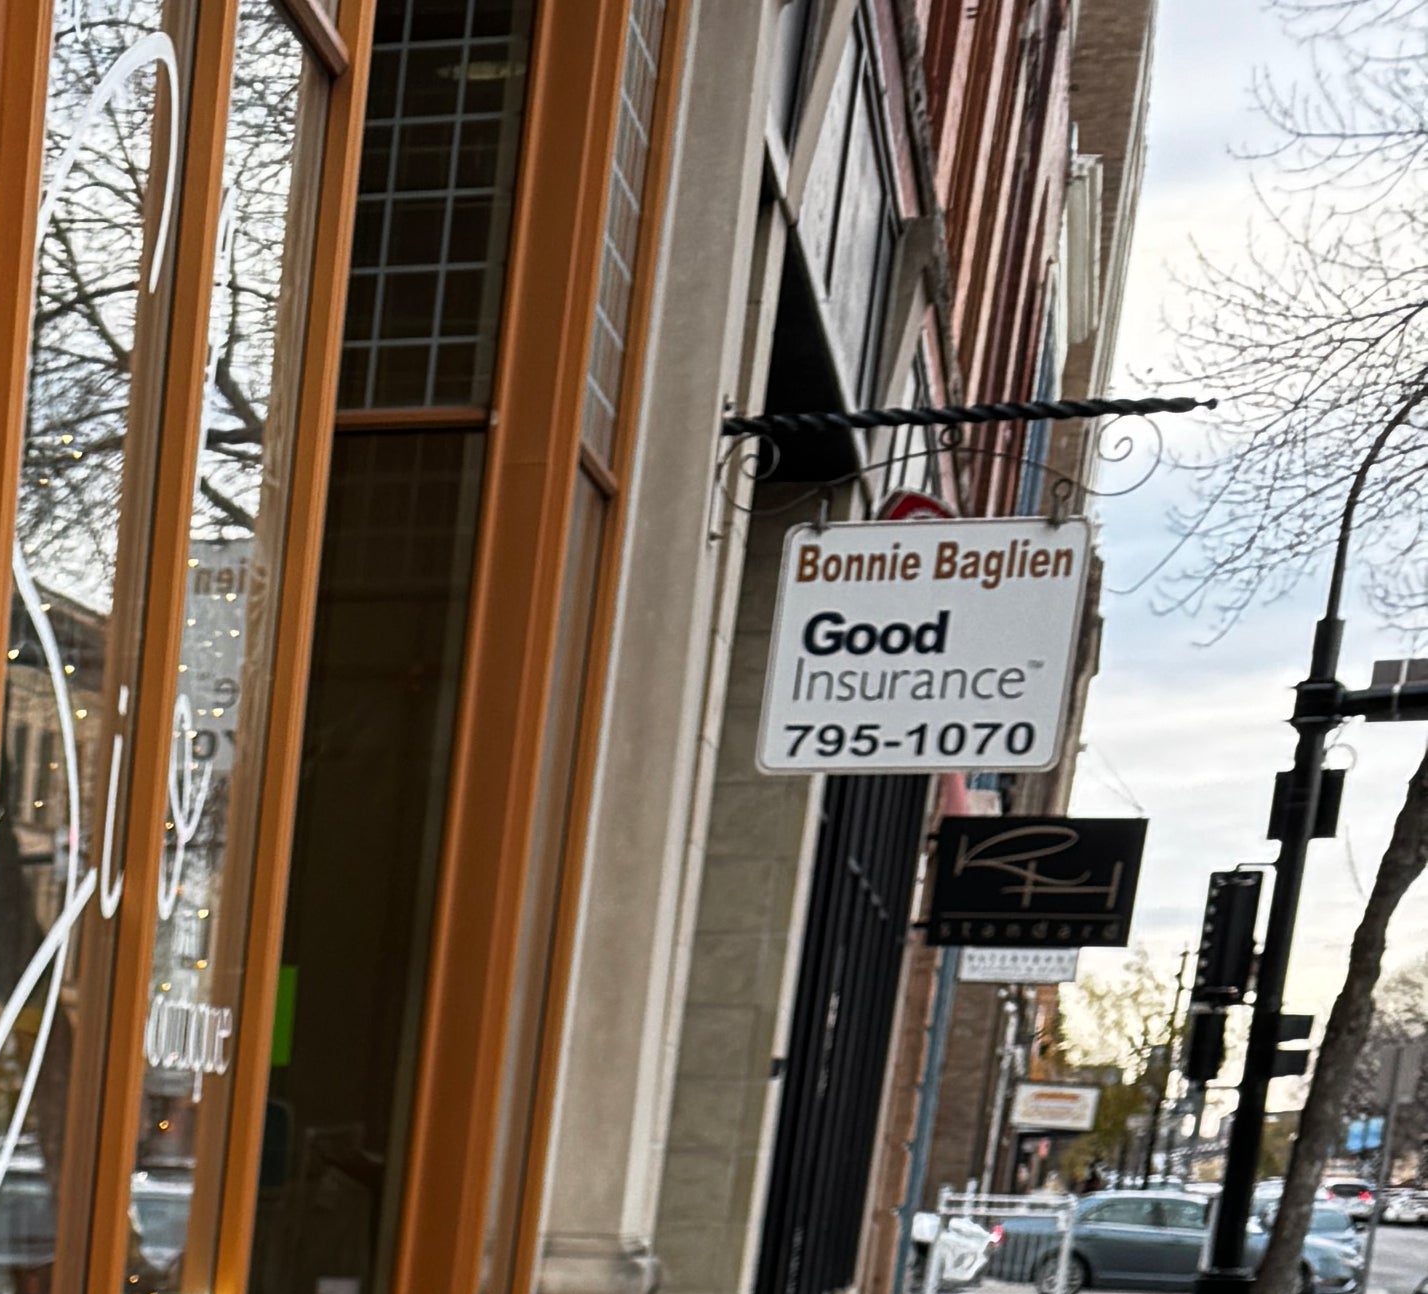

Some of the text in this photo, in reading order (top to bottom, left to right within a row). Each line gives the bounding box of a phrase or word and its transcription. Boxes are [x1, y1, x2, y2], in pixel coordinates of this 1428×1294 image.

[795, 539, 1074, 590] Bonnie Baglien
[802, 610, 951, 657] Good
[791, 657, 1027, 702] Insurance
[783, 721, 1037, 759] 795-1070
